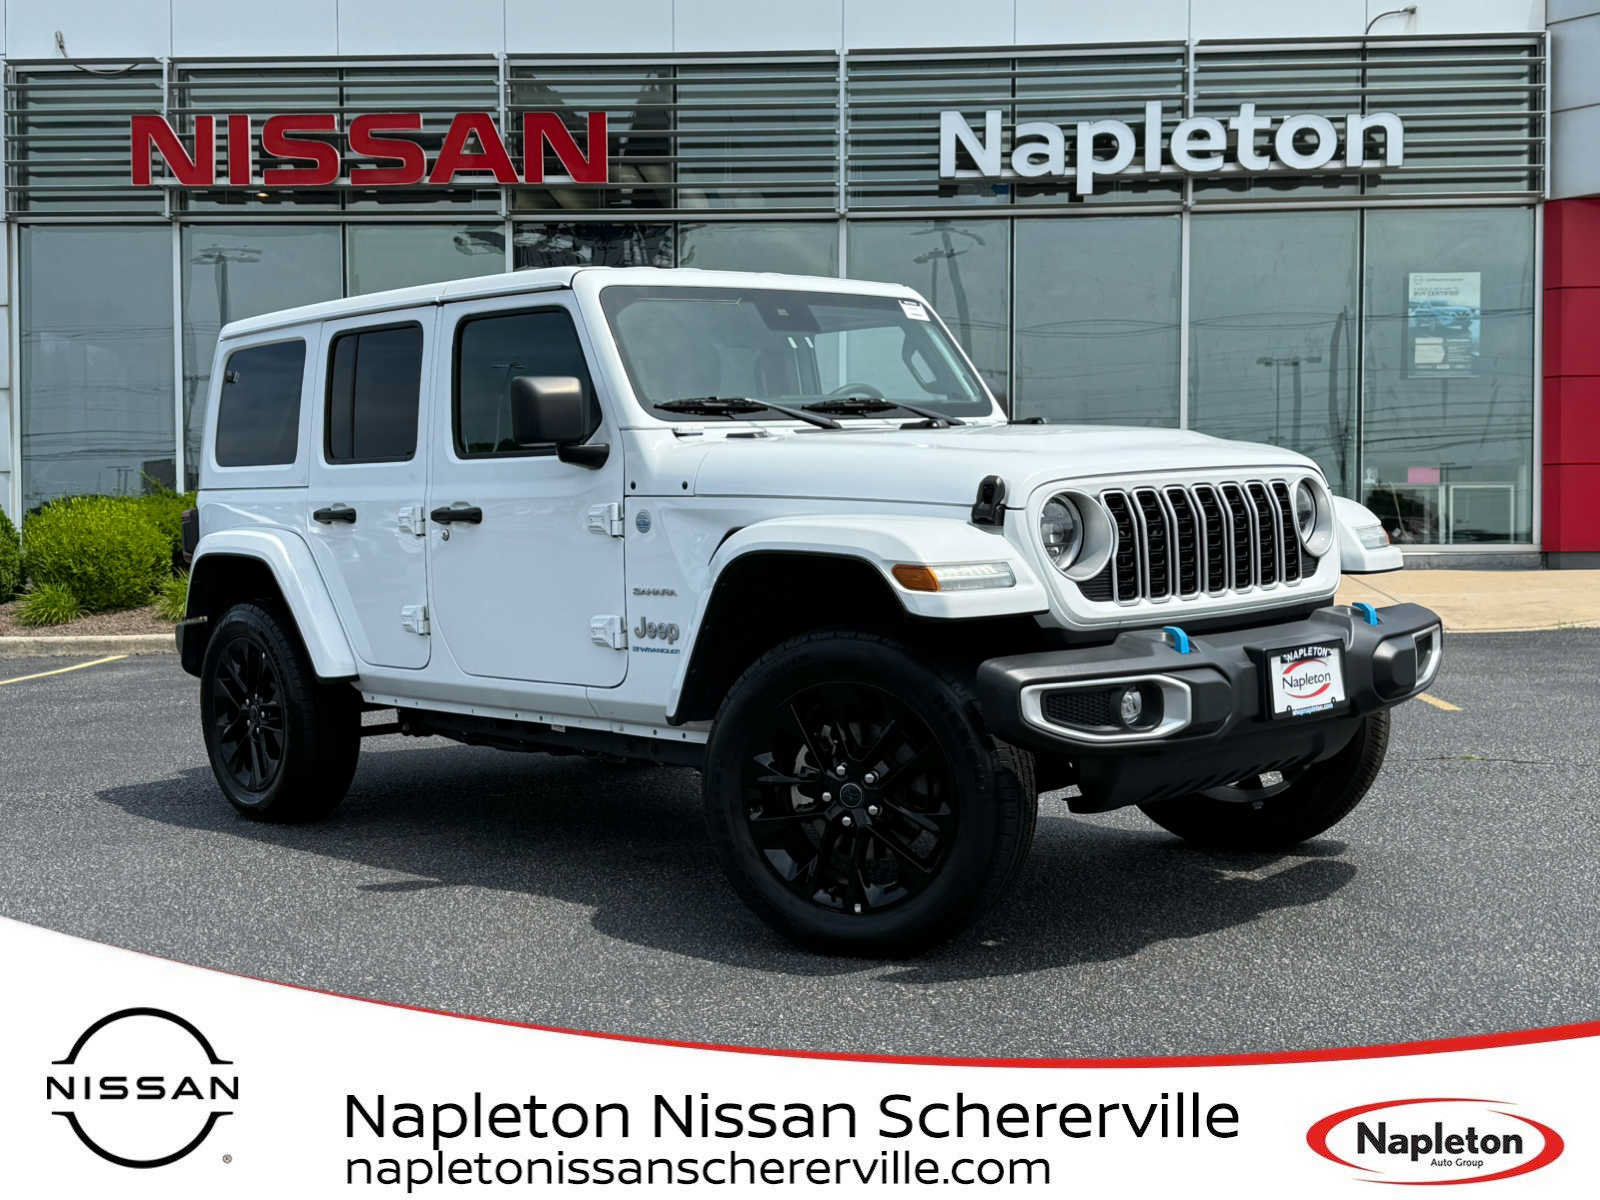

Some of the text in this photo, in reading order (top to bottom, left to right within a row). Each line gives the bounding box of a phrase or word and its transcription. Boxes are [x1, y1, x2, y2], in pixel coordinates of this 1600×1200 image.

[131, 112, 609, 186] NISSAN
[938, 100, 1404, 195] Napleton
[632, 587, 678, 597] SAHARA
[634, 616, 680, 645] Jeep
[1287, 646, 1328, 662] NAPLETON
[1282, 671, 1332, 691] Napleton
